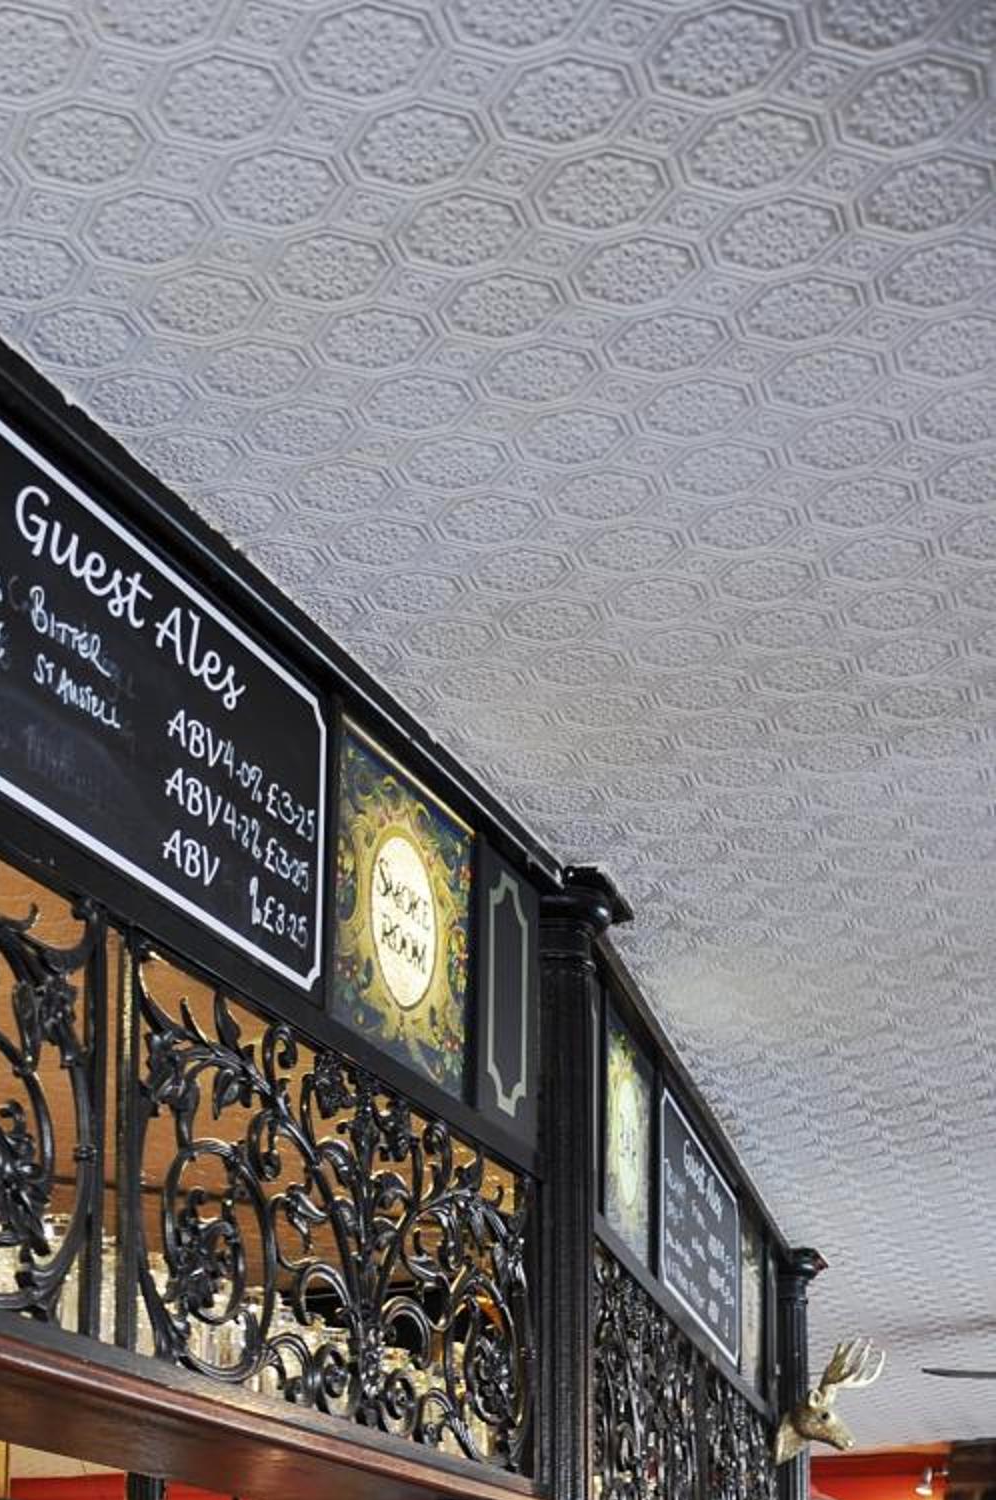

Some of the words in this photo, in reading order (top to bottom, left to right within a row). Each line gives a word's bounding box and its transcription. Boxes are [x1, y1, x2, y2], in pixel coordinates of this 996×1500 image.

[16, 486, 152, 628] Guest
[156, 607, 246, 710] Ales
[167, 710, 223, 768] ABV
[165, 768, 222, 826] ABV
[163, 829, 220, 886] ABV
